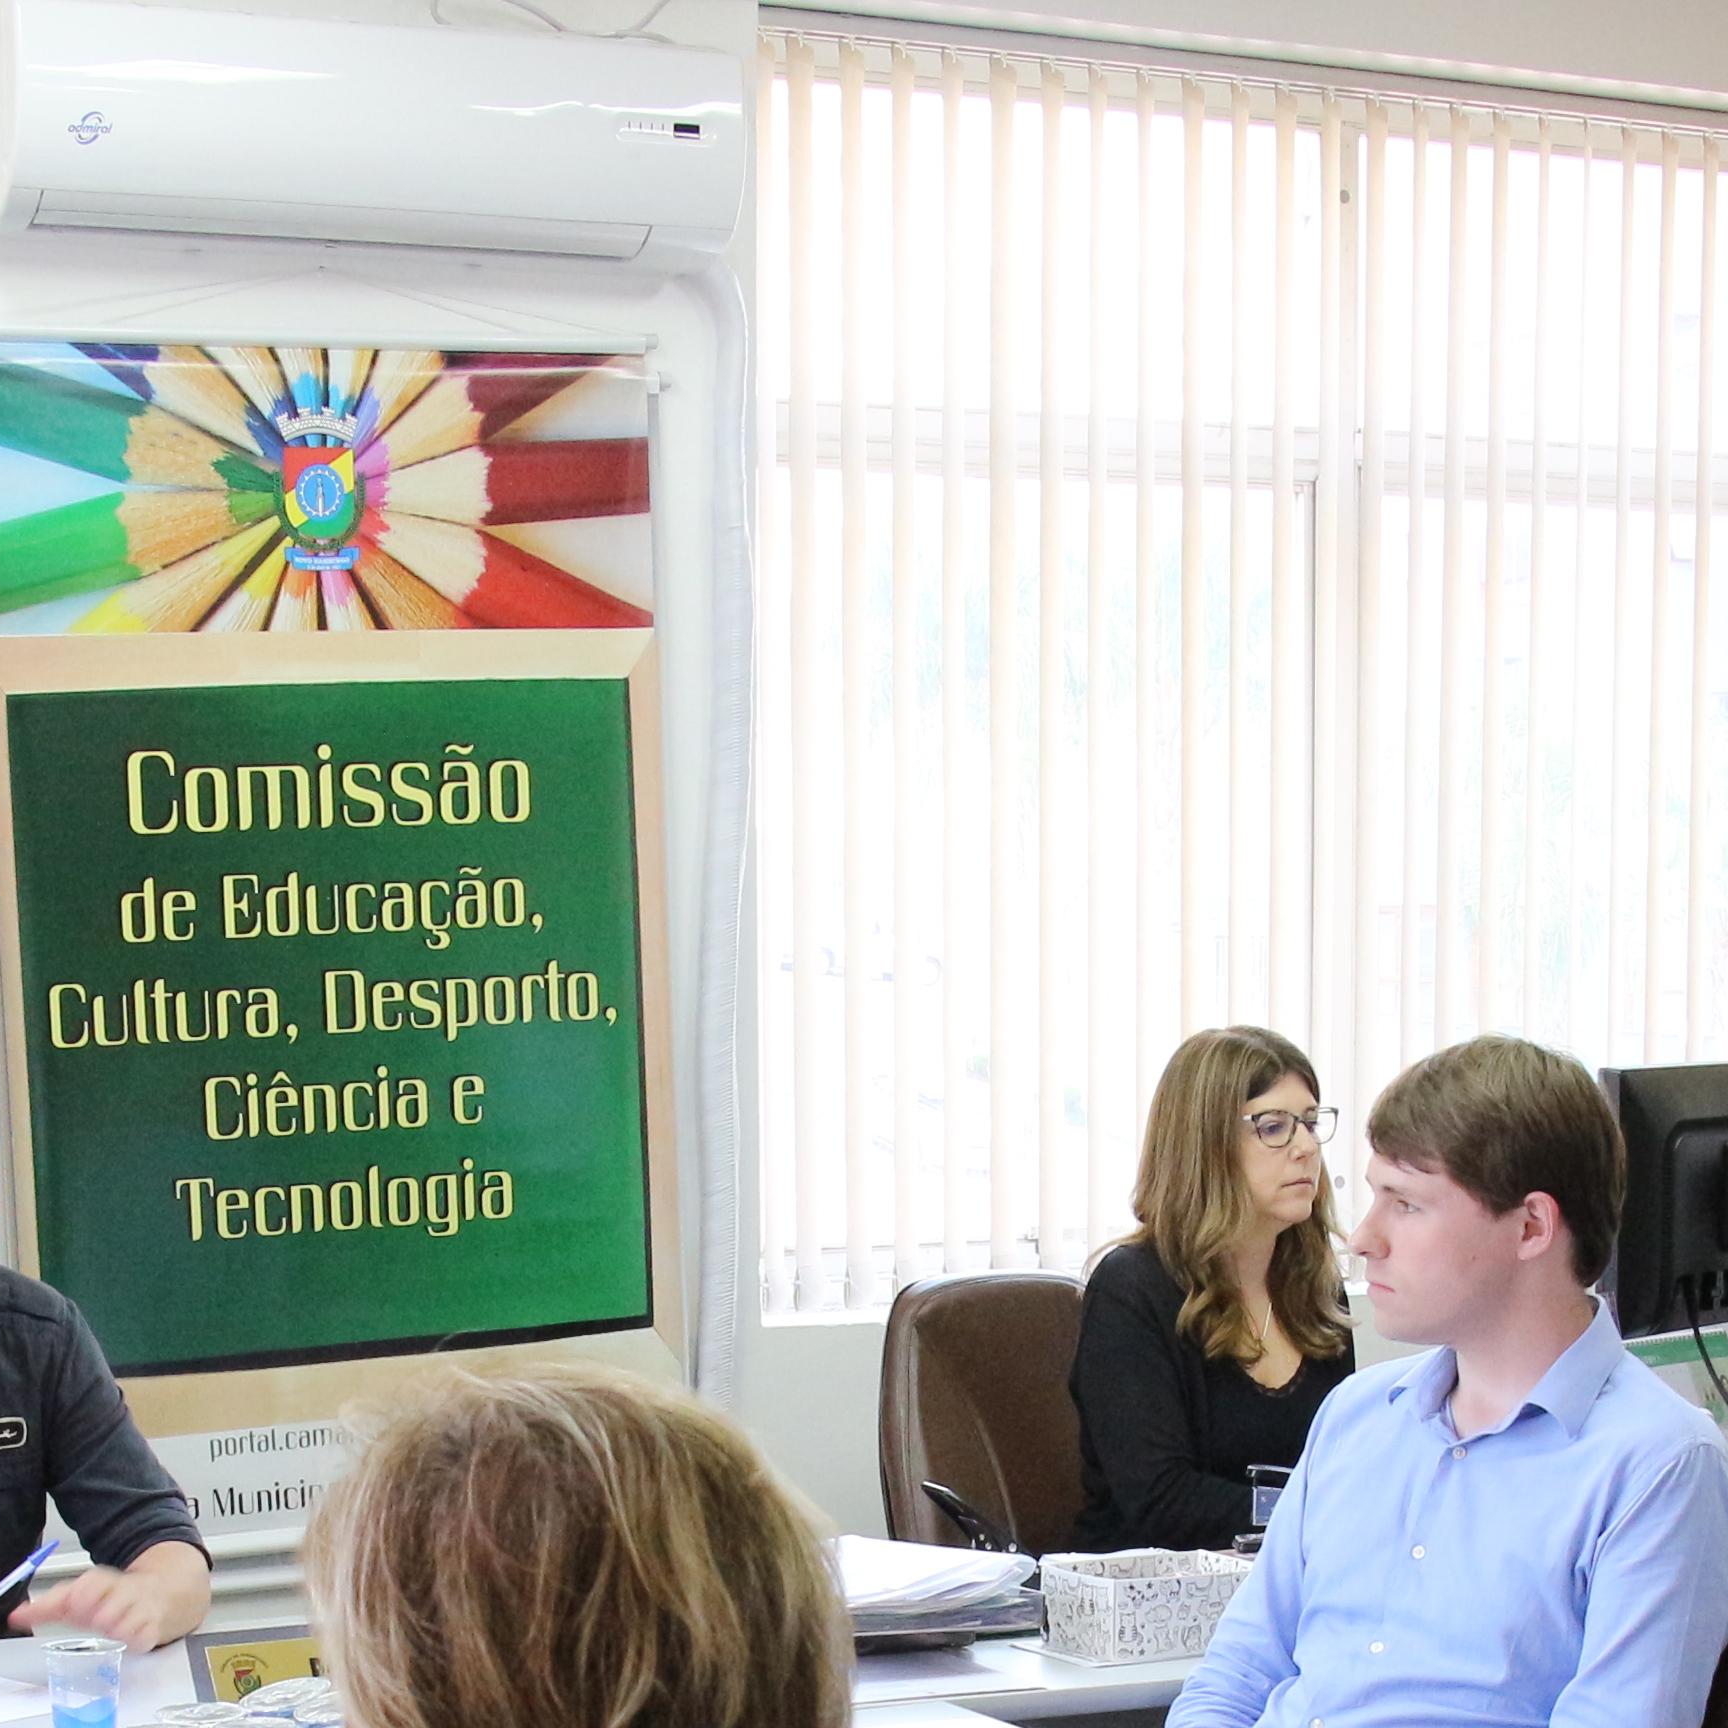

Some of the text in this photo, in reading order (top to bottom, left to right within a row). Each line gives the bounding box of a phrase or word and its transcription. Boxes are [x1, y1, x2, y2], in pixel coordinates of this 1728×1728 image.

[126, 743, 532, 837] Comissão
[120, 866, 546, 950] de Educação,
[48, 959, 619, 1049] Cultura, Desporto,
[203, 1065, 486, 1141] Ciência e
[175, 1158, 514, 1242] Tecnologia
[209, 1426, 355, 1463] portal.cama
